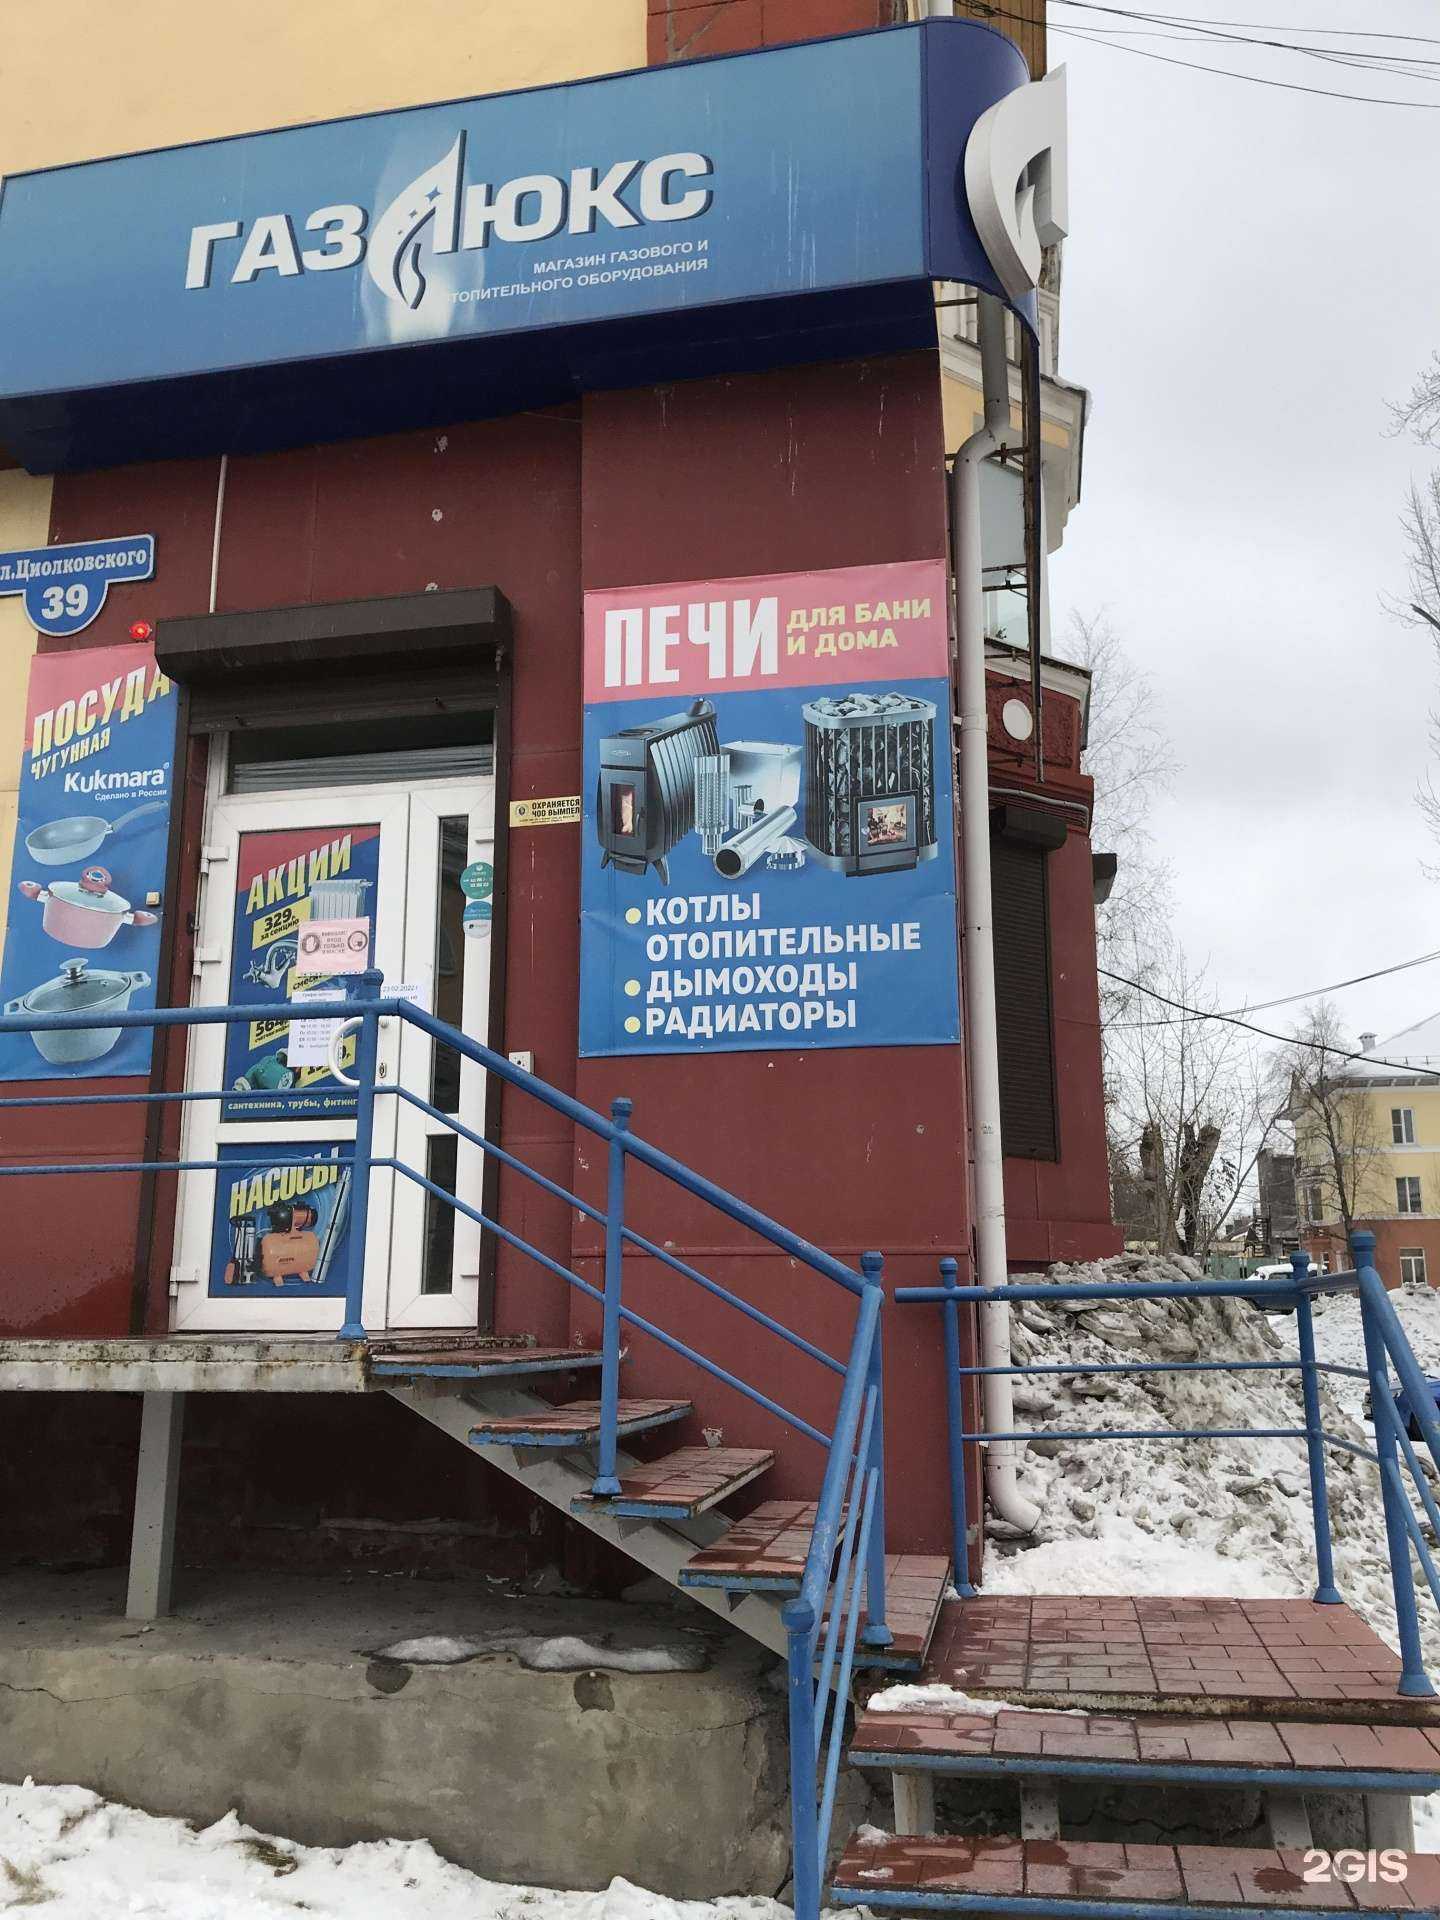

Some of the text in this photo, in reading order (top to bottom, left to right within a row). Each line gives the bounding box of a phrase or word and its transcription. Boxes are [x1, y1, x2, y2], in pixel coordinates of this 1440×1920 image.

[533, 240, 709, 274] МАГАЗИН ГАЗОВОГО И
[450, 258, 709, 304] ТОПИТЕЛЬНОГО ОБОРУДОВАНИЯ
[0, 548, 147, 582] л.Циолковского
[41, 583, 89, 620] 39
[604, 597, 931, 688] ПЕЧИ ДЛЯ БАНИ
[787, 628, 898, 657] И ДОМА
[31, 661, 170, 760] ПОСУДА
[31, 727, 110, 780] ЧУГУННАЯ
[531, 799, 580, 810] ОХРАНЯЕТСЯ
[246, 834, 352, 915] АКЦИИ
[646, 893, 761, 926] КОТЛЫ
[646, 922, 921, 962] ОТОПИТЕЛЬНЫЕ
[646, 962, 857, 1004] ДЫМОХОДЫ
[646, 999, 857, 1039] РАДИАТОРЫ
[323, 1097, 358, 1108] фитинг
[230, 1147, 339, 1221] НАСОСЫ
